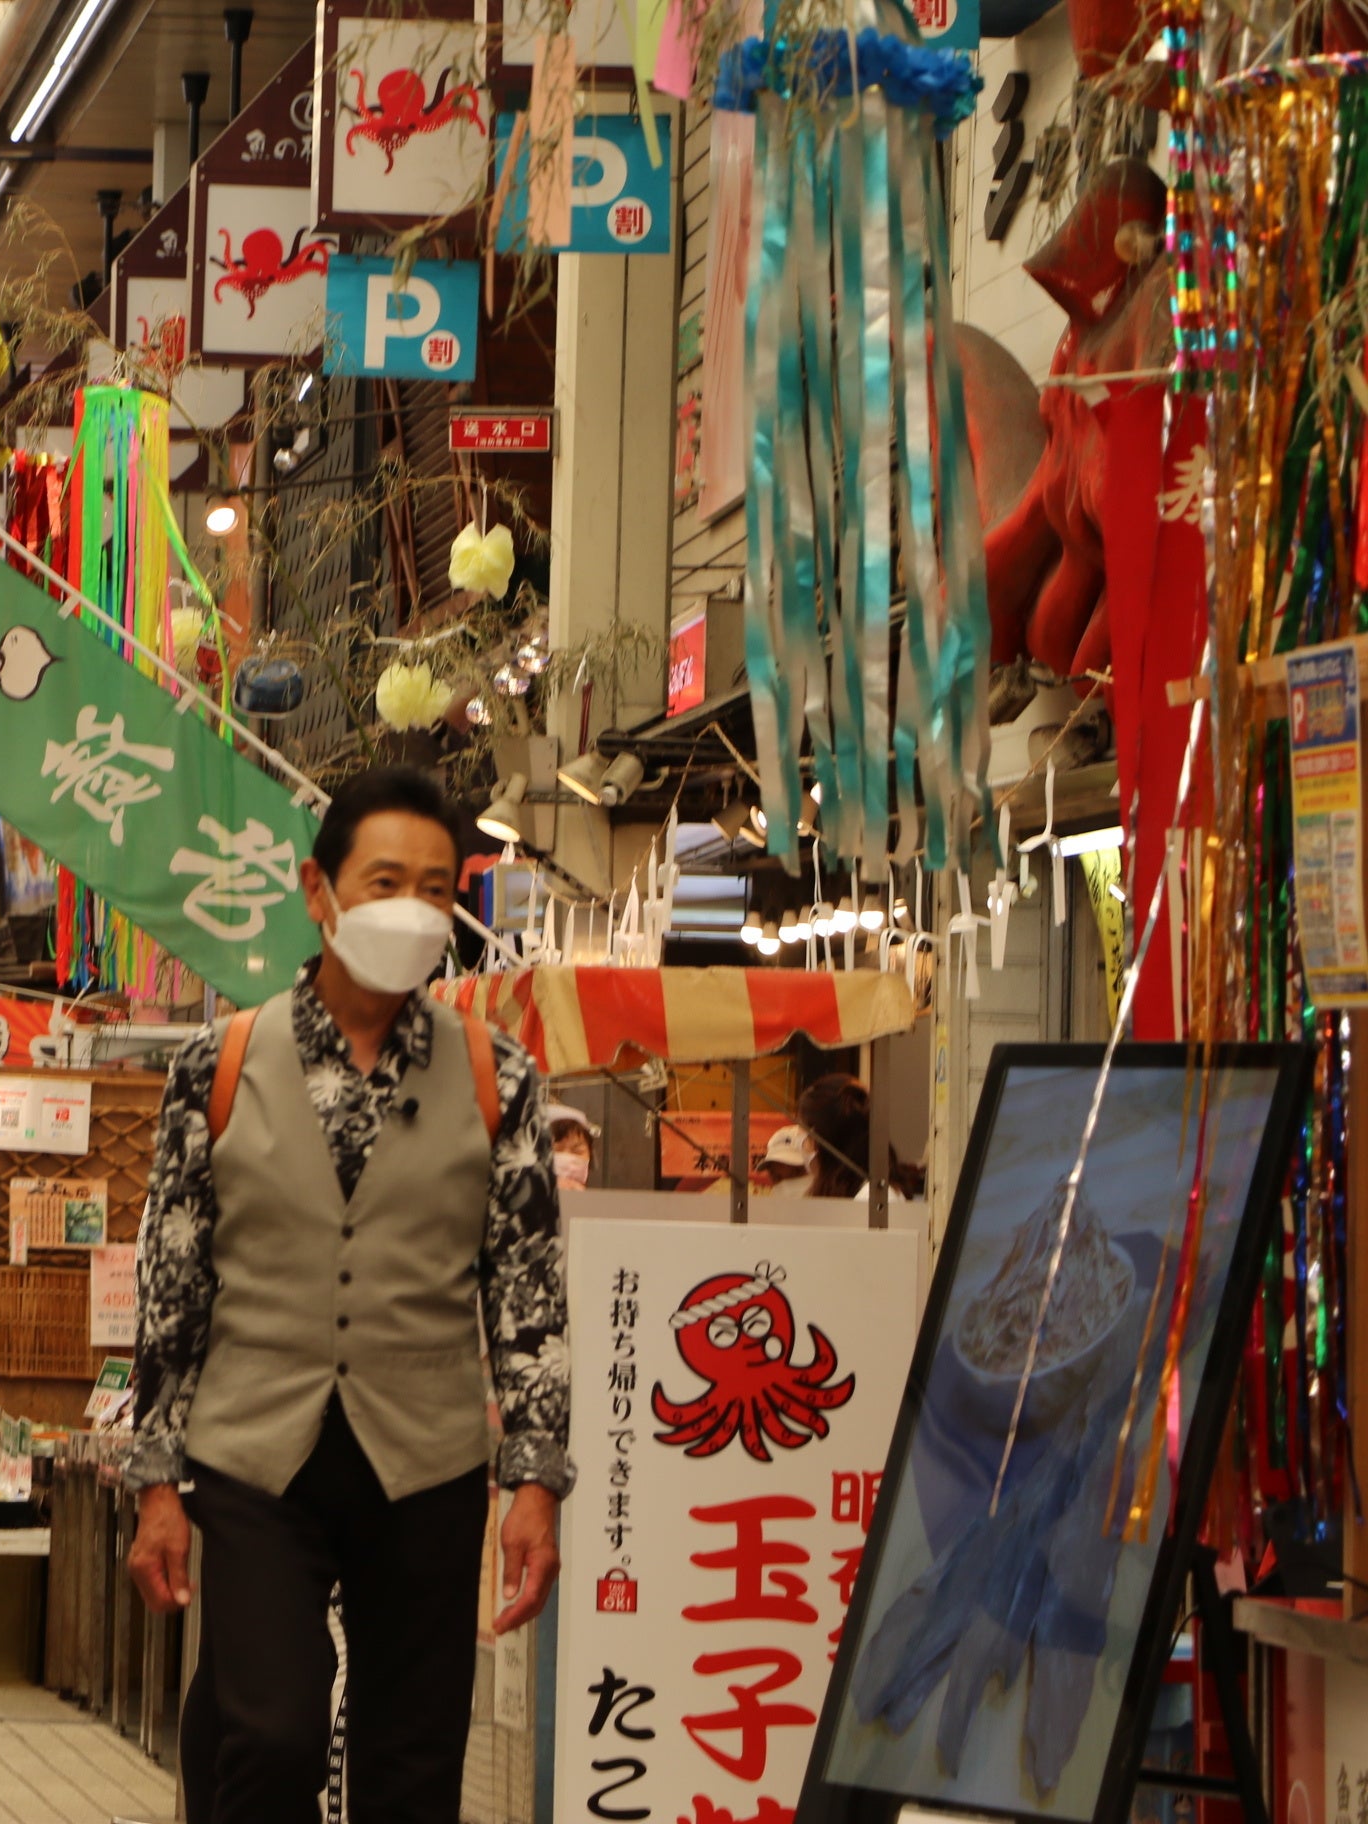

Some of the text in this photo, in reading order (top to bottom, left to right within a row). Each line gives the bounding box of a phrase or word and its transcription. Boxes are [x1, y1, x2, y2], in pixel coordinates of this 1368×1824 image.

[615, 205, 644, 237] 割
[364, 275, 441, 369] P
[428, 338, 454, 365] 割
[604, 1266, 639, 1567] お持ち帰りできます。
[587, 1666, 656, 1821] たこ
